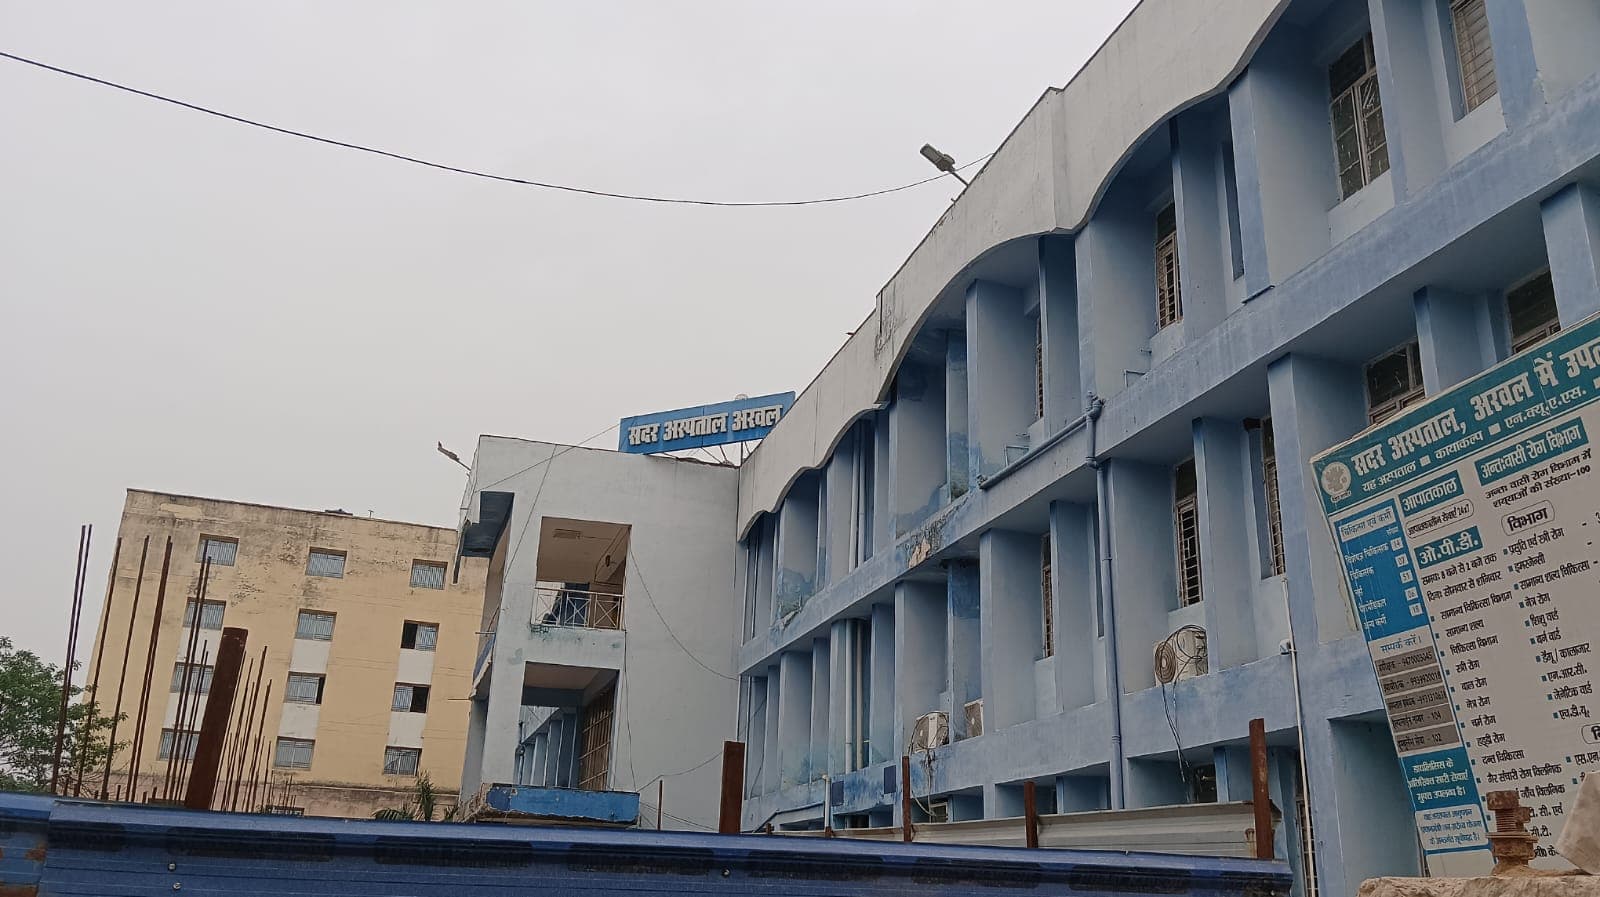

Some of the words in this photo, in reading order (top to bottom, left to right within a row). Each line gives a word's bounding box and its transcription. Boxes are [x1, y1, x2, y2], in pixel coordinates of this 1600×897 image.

[1351, 444, 1386, 476] सदर
[1387, 408, 1467, 460] अस्पताल,
[1470, 372, 1534, 421] अरवल
[1533, 351, 1559, 387] में
[628, 423, 661, 446] सदर
[662, 412, 729, 441] अस्पताल
[732, 404, 783, 432] अरवल
[1526, 439, 1547, 459] रोग
[1546, 425, 1581, 451] विभाग
[1362, 481, 1377, 491] यह
[1378, 461, 1416, 485] अस्पताल
[1435, 430, 1484, 459] कायाकल्प
[1510, 474, 1530, 489] वासी
[1530, 468, 1549, 481] रोग
[1550, 455, 1581, 473] विभाग
[1580, 448, 1592, 460] में
[1402, 478, 1457, 511] आपातकाल
[1530, 482, 1543, 494] की
[1507, 508, 1549, 531] विभाग
[1527, 533, 1538, 549] एवं
[1551, 528, 1565, 540] रोग
[1419, 532, 1479, 564] ओ.पी.डी.
[1458, 562, 1466, 573] से
[1483, 552, 1498, 565] तक
[1519, 575, 1544, 591] सामान्य
[1544, 568, 1561, 583] शल्य
[1560, 559, 1590, 579] चिकित्सा
[1443, 582, 1469, 598] सोमवार
[1468, 578, 1476, 590] से
[1475, 571, 1502, 587] शनिवार
[1440, 605, 1463, 620] सामान्य
[1463, 598, 1490, 613] चिकित्सा
[1490, 590, 1513, 605] विभाग
[1525, 596, 1537, 608] नेत्र
[1537, 592, 1551, 604] रोग
[1545, 607, 1560, 621] वार्ड
[1445, 623, 1468, 638] सामान्य
[1548, 627, 1562, 641] वार्ड
[1450, 641, 1477, 655] चिकित्सा
[1476, 635, 1499, 648] विभाग
[1558, 643, 1591, 659] कालाजार
[1467, 659, 1480, 671] रोग
[1474, 677, 1488, 689] रोग
[1579, 681, 1593, 695] वार्ड
[1477, 696, 1491, 708] रोग
[1482, 714, 1496, 726] रोग
[1493, 732, 1506, 744] रोग
[1496, 750, 1525, 763] चिकित्सा
[1498, 768, 1518, 782] संचारी
[1518, 767, 1533, 779] रोग
[1552, 802, 1564, 816] एवं
